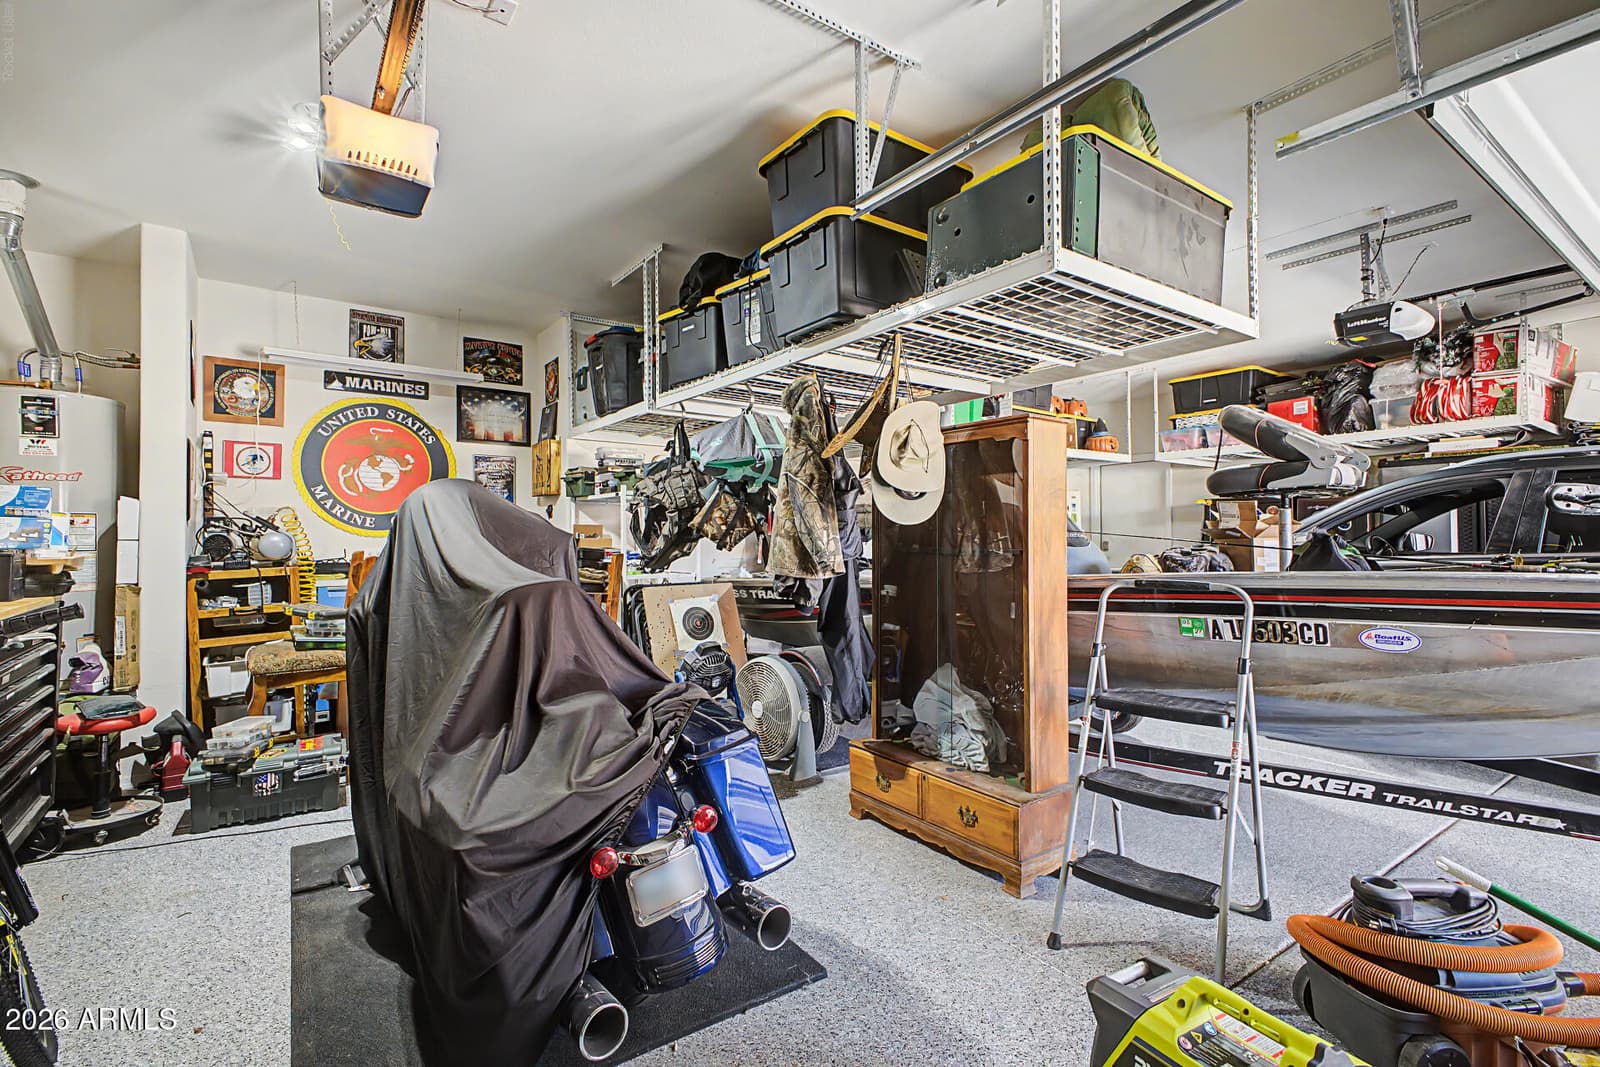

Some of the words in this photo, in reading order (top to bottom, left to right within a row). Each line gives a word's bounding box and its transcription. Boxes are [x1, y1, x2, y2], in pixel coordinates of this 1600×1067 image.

[344, 375, 425, 396] MARINES
[317, 406, 379, 437] UNITED
[385, 409, 437, 445] STATES
[311, 484, 376, 529] MARINE
